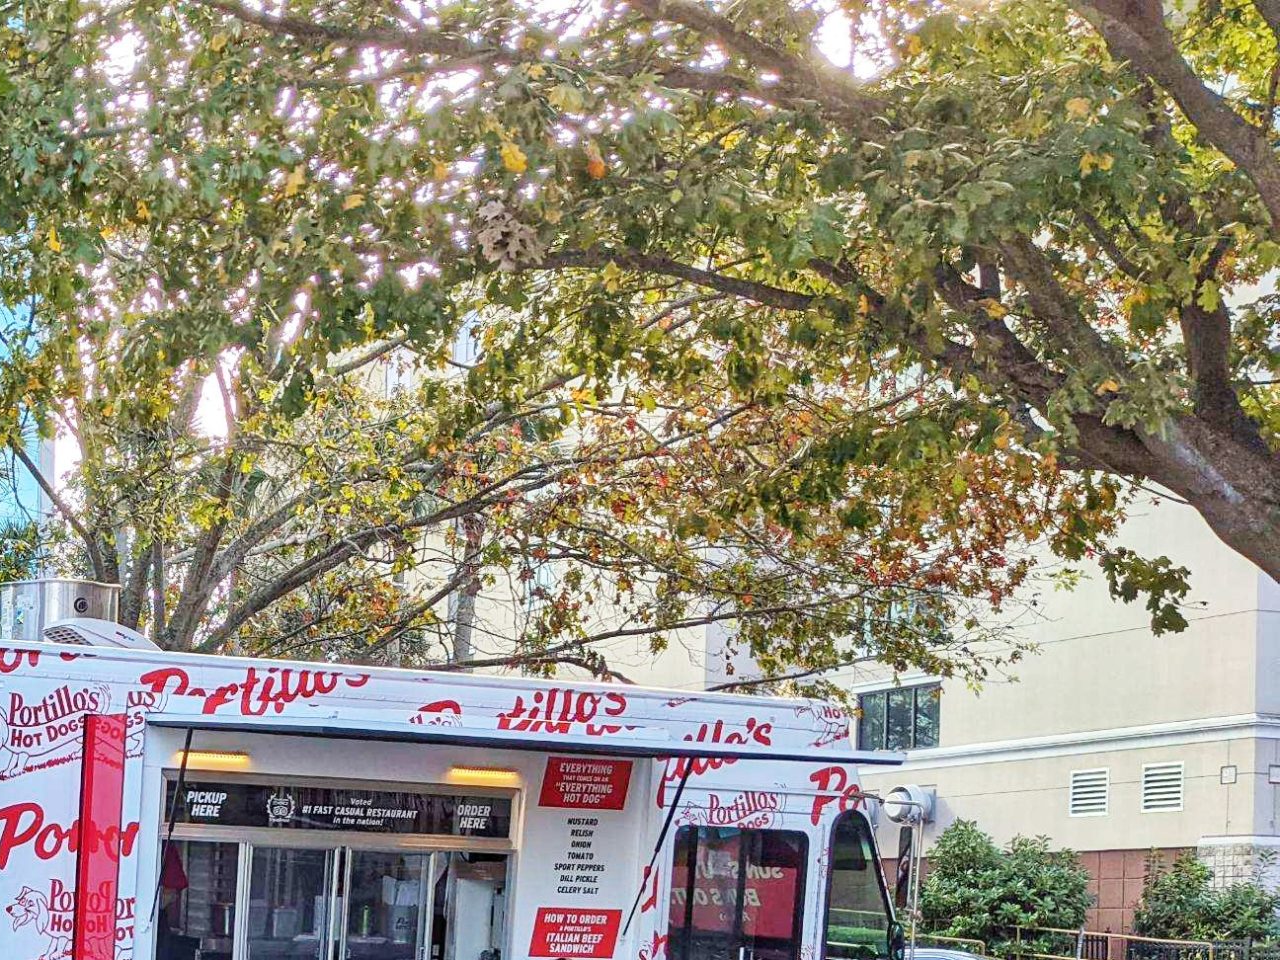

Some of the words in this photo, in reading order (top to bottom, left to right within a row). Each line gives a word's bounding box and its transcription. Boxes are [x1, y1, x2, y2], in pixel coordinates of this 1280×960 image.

[9, 685, 100, 727] Portillo's
[11, 728, 43, 748] HOT
[46, 716, 85, 741] DOGS
[559, 762, 614, 775] EVERYTHING
[556, 782, 614, 794] "EVERYTHING
[186, 790, 228, 804] PICKUP
[350, 798, 373, 806] Voted
[563, 793, 580, 803] HOT
[190, 804, 221, 818] HERE
[302, 805, 312, 815] #1
[313, 806, 333, 815] FAST
[335, 807, 365, 817] CASUAL
[366, 808, 418, 820] RESTAURANT
[457, 804, 491, 817] ORDER
[708, 790, 779, 826] Portillo's
[339, 817, 355, 825] the
[356, 818, 384, 826] nation!
[459, 817, 487, 830] HERE
[567, 818, 598, 826] MUSTARD
[570, 829, 594, 838] RELISH
[567, 852, 594, 860] TOMATO
[554, 862, 576, 871] SPORT
[576, 863, 605, 872] PEPPERS
[560, 874, 573, 882] DILL
[575, 875, 598, 883] PICKLE
[557, 886, 581, 894] CELERY
[582, 887, 599, 895] SALT
[544, 913, 565, 924] HOW
[566, 914, 577, 923] TO
[579, 915, 607, 925] ORDER
[546, 932, 580, 943] ITALIAN
[581, 934, 604, 944] BEEF
[549, 943, 595, 954] SANDWICH
